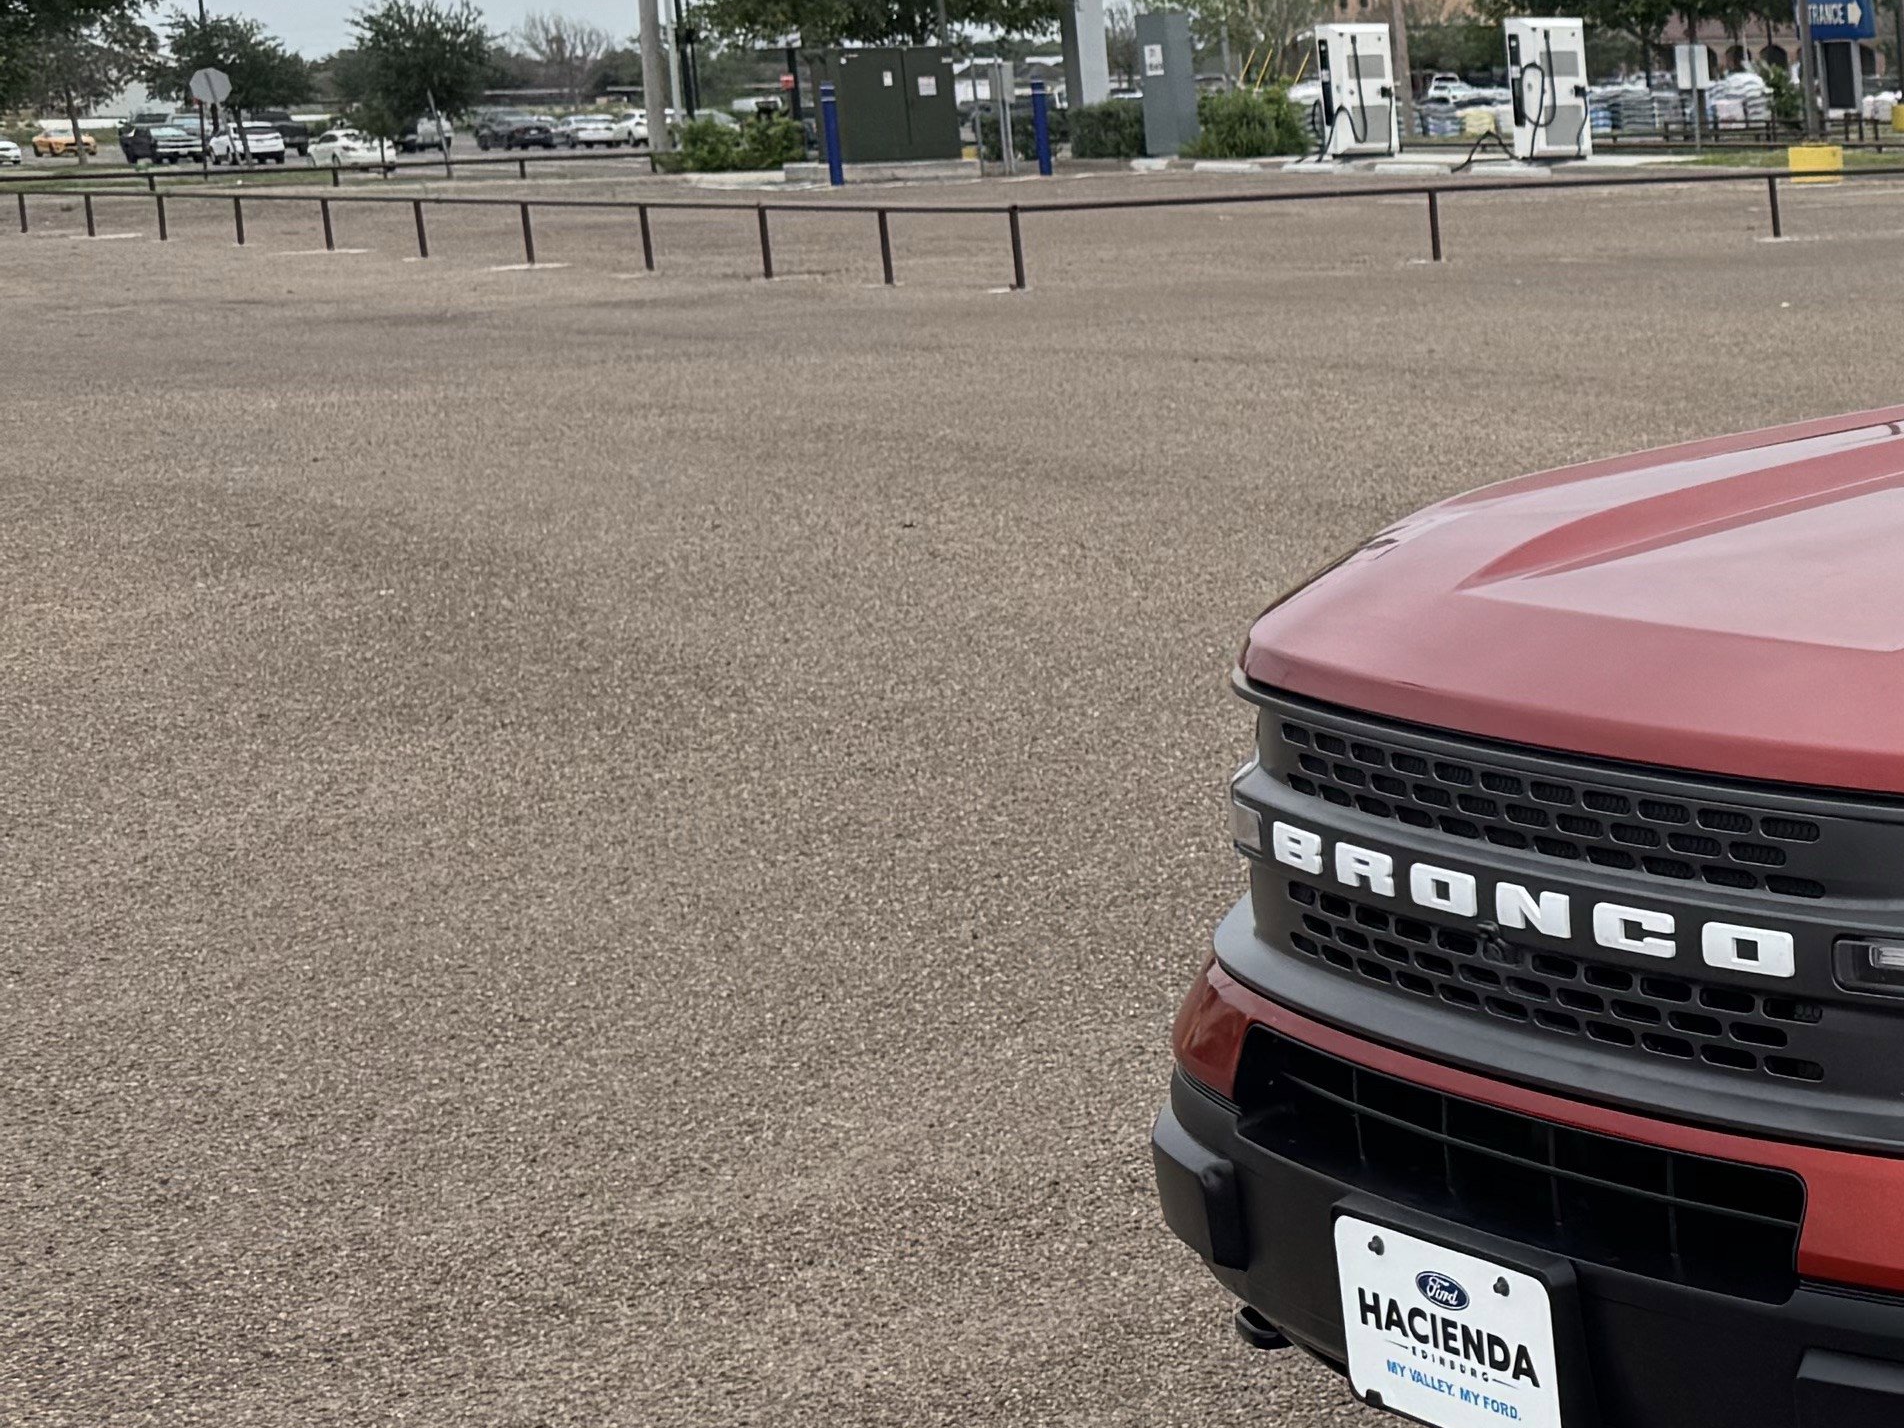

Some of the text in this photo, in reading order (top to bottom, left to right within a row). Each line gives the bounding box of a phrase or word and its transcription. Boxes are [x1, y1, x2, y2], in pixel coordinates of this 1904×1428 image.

[1272, 820, 1796, 978] BRONCO
[1425, 1274, 1459, 1307] Ford
[1357, 1286, 1541, 1388] HACIENDA
[1412, 1345, 1489, 1383] EDINBURG
[1386, 1359, 1522, 1422] MY VALLEY. MY FORD.
